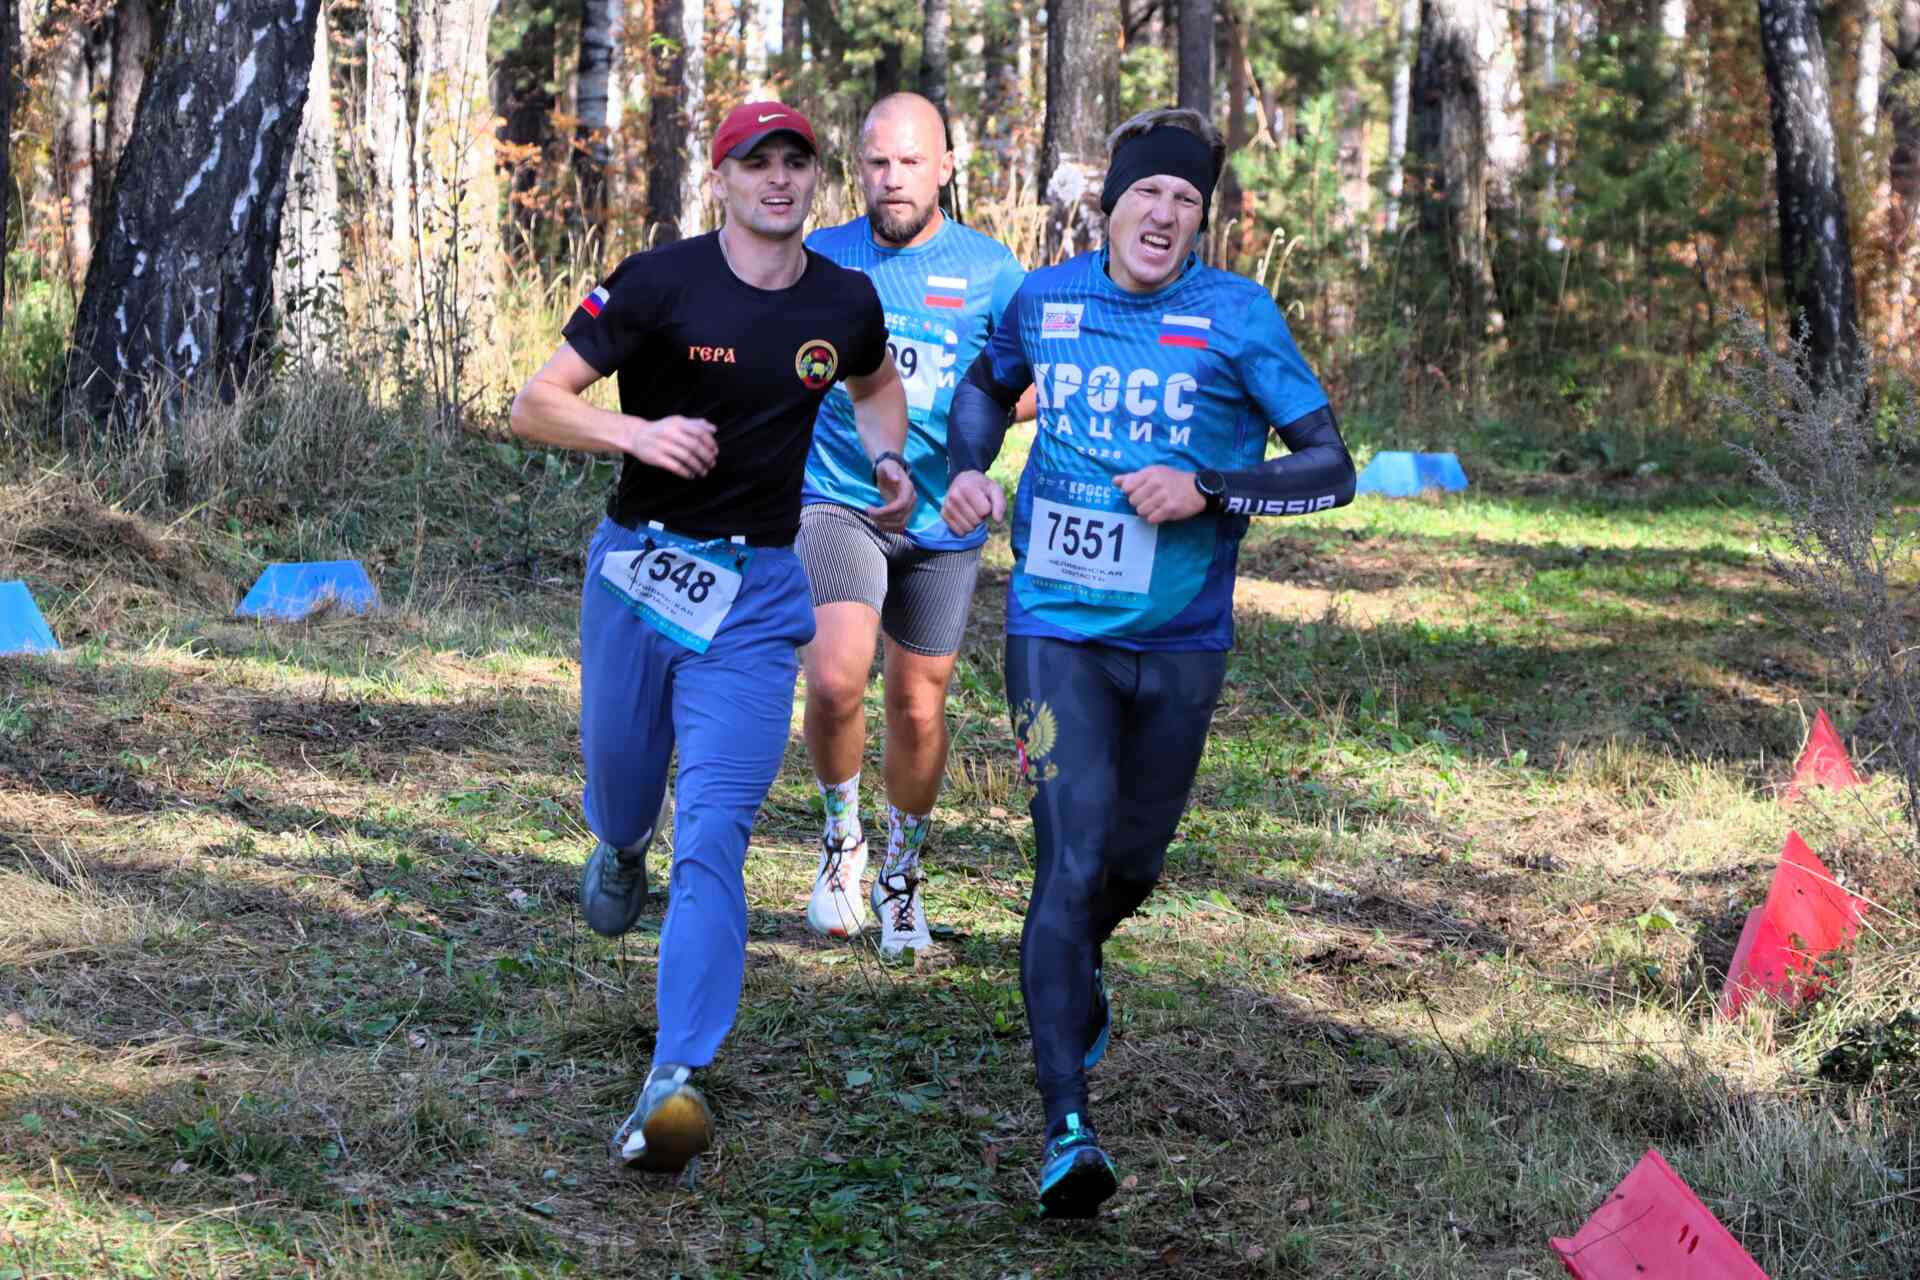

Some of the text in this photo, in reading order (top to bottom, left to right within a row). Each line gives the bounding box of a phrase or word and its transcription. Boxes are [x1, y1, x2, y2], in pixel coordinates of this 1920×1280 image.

[1033, 363, 1198, 421] КРОСС
[1068, 481, 1112, 498] КРОСС
[1226, 494, 1336, 515] RUSSIA
[1048, 511, 1124, 562] 7551
